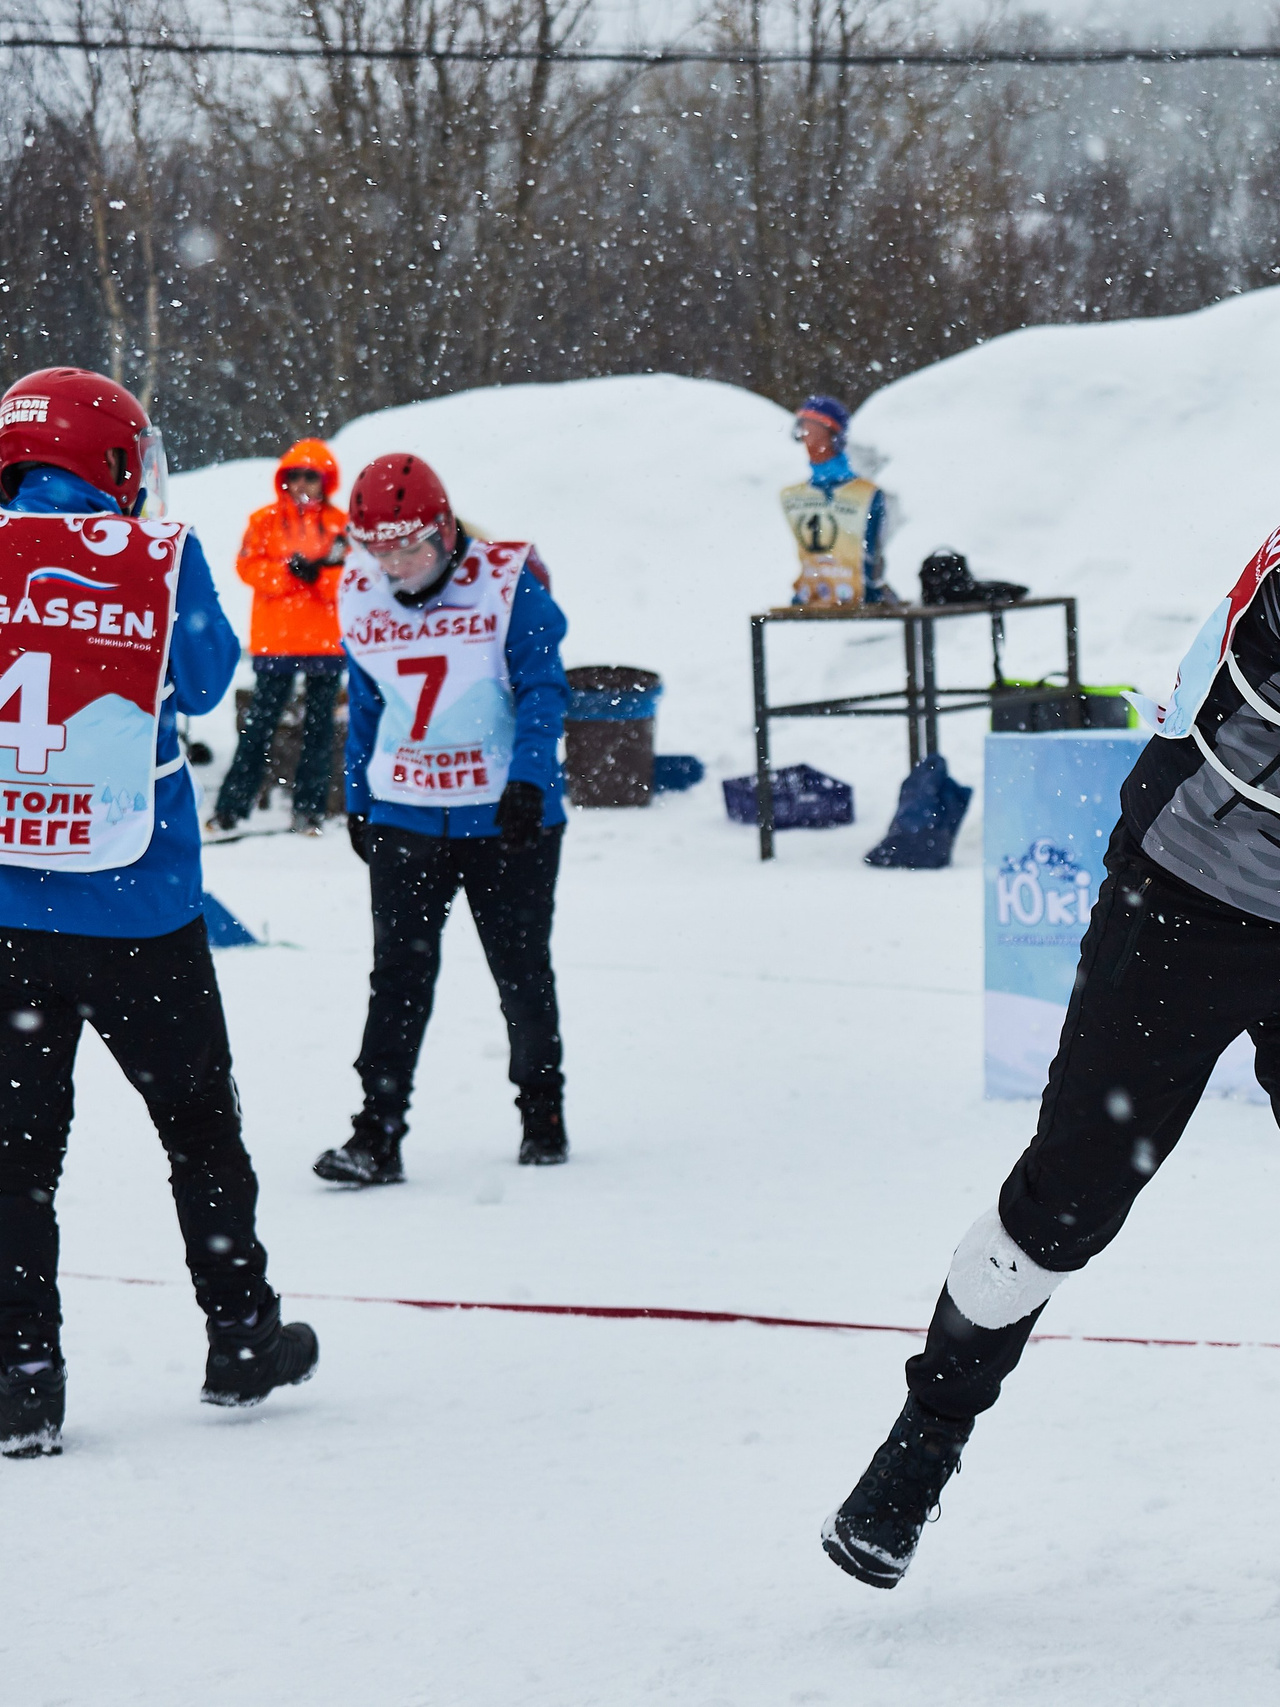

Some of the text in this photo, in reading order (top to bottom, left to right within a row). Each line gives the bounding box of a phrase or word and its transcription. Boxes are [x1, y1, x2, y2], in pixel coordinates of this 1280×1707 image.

[15, 399, 50, 410] ТОЛК
[397, 655, 448, 742] 7
[0, 651, 66, 774] 4
[424, 750, 484, 768] ТОЛК
[3, 790, 94, 815] ТОЛК
